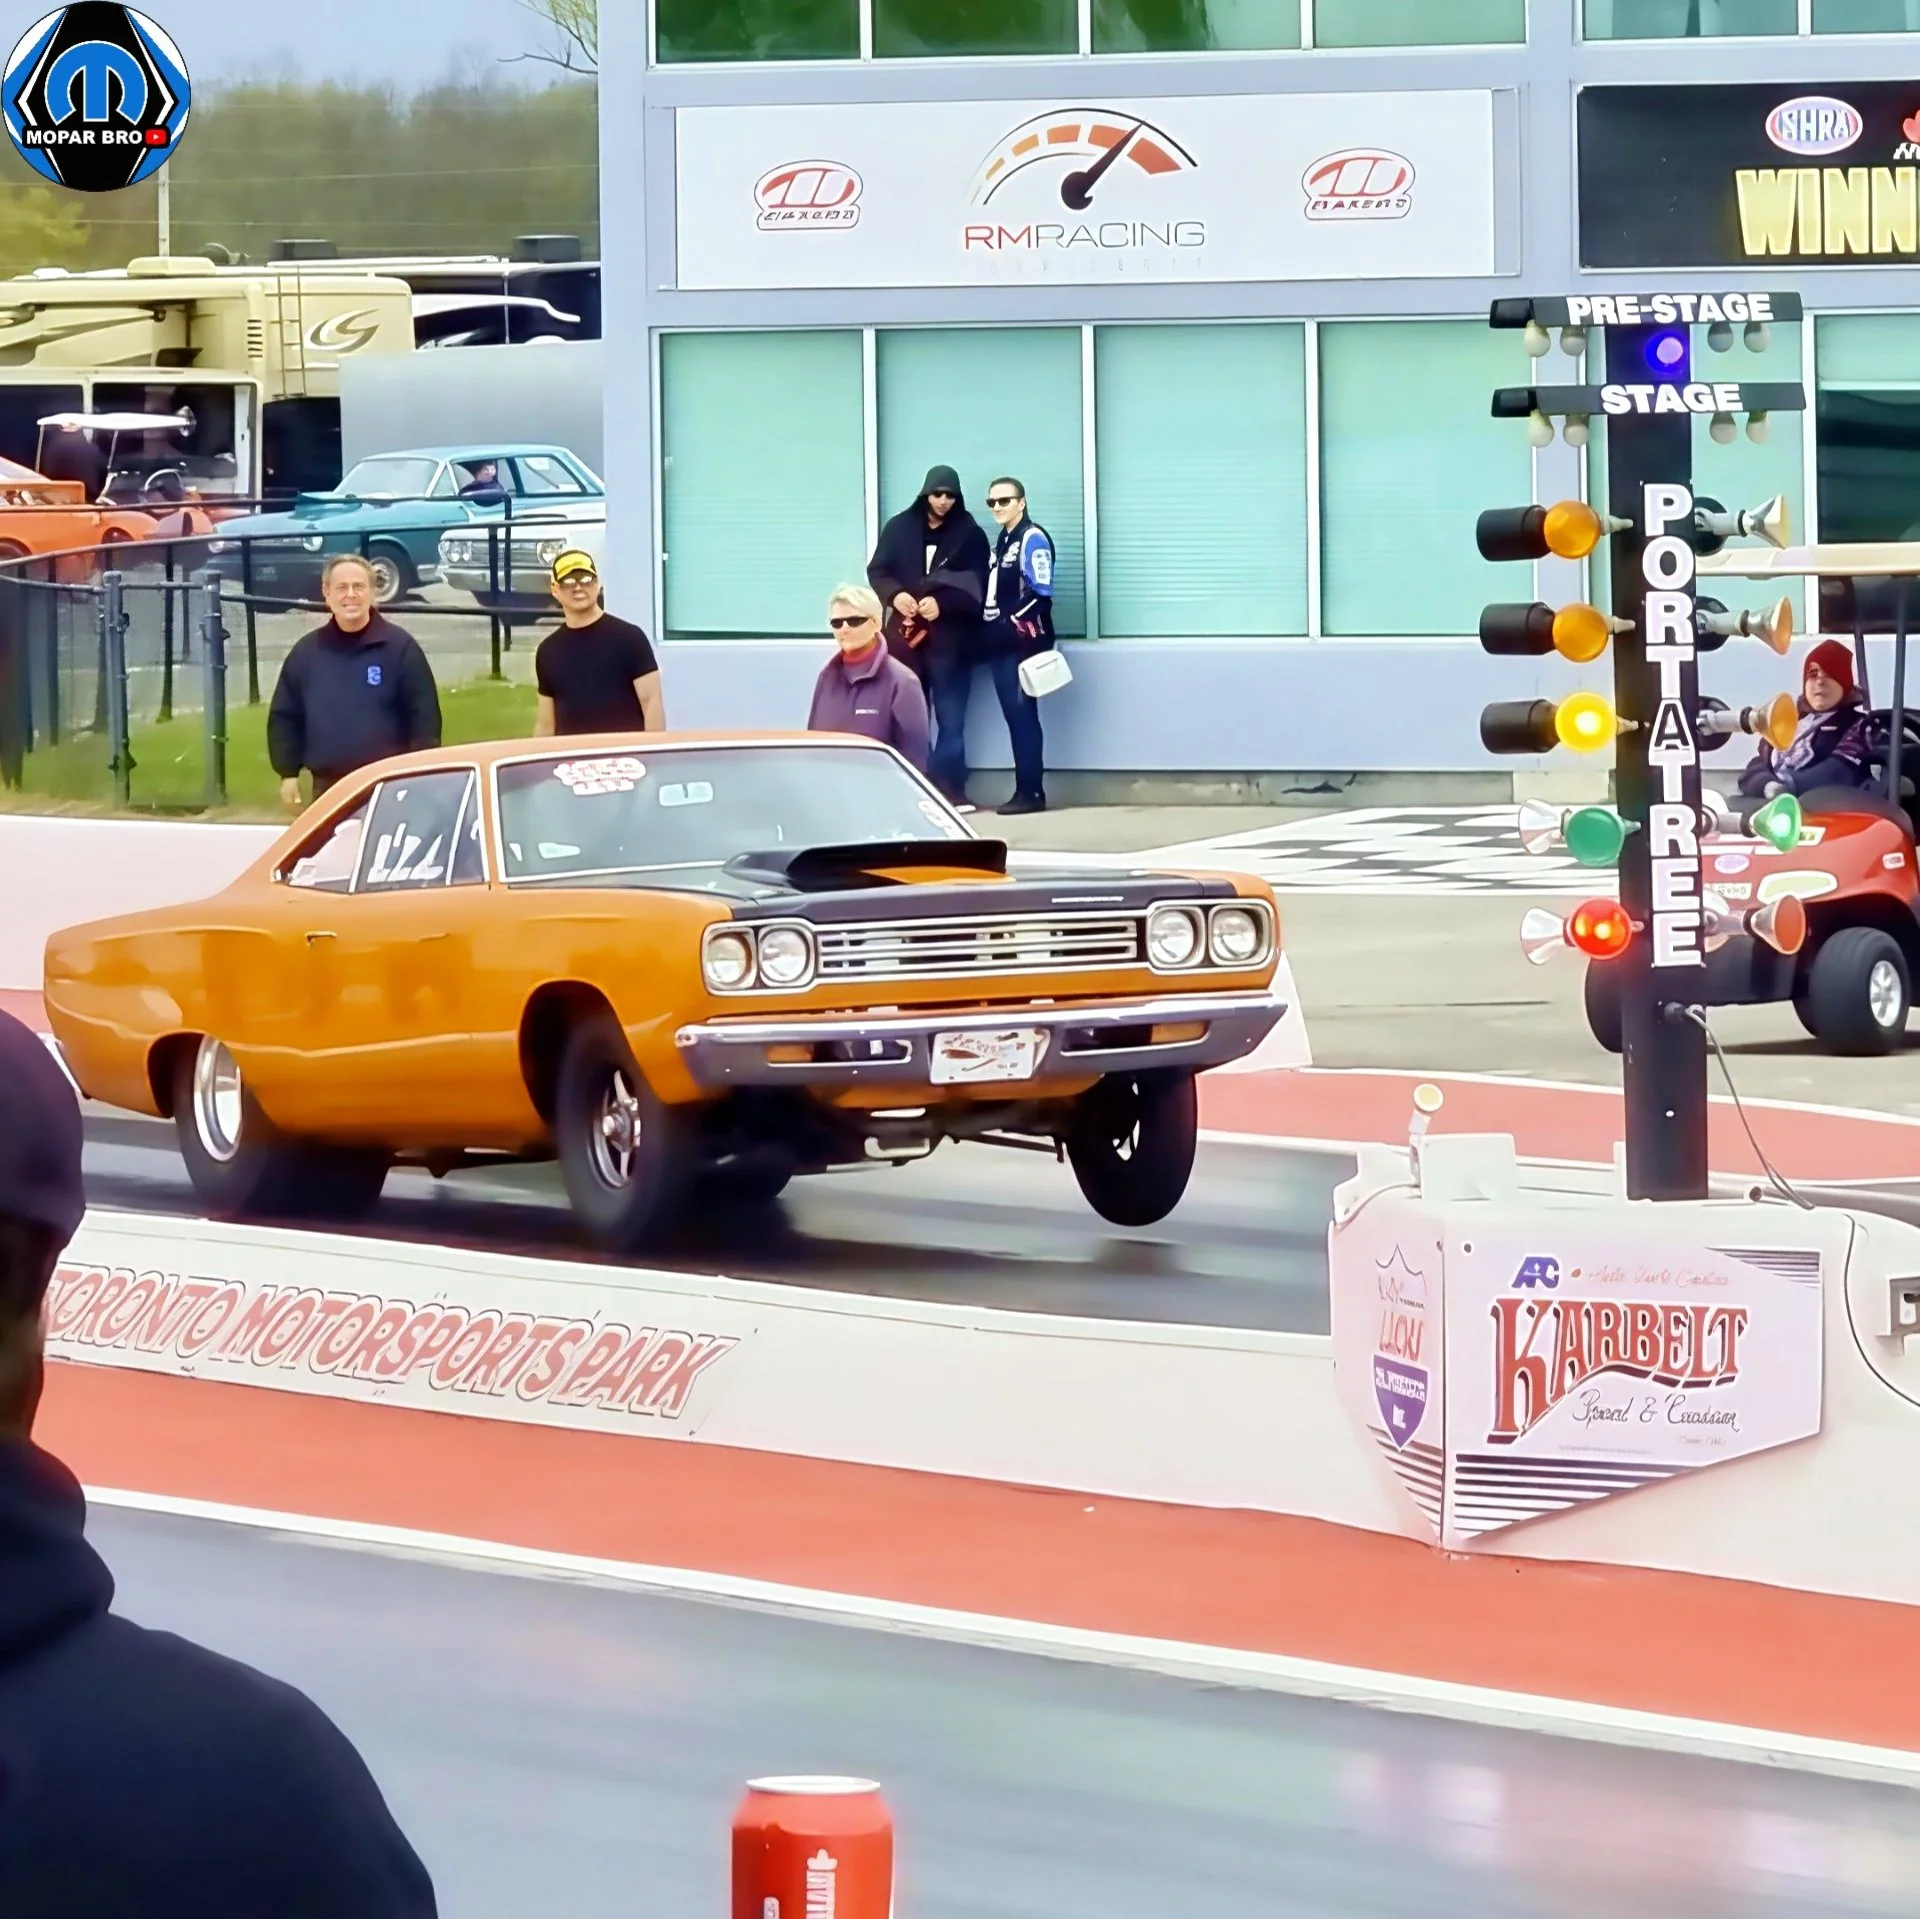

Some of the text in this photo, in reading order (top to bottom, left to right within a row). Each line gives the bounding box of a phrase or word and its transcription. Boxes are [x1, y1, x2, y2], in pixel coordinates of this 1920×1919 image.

[1735, 167, 1920, 255] WINN
[1566, 293, 1774, 325] PRE-STAGE
[1600, 383, 1744, 414] STAGE
[43, 1262, 248, 1358] TORONTO
[548, 1323, 741, 1419] PARK
[1487, 1298, 1749, 1445] KARBELT
